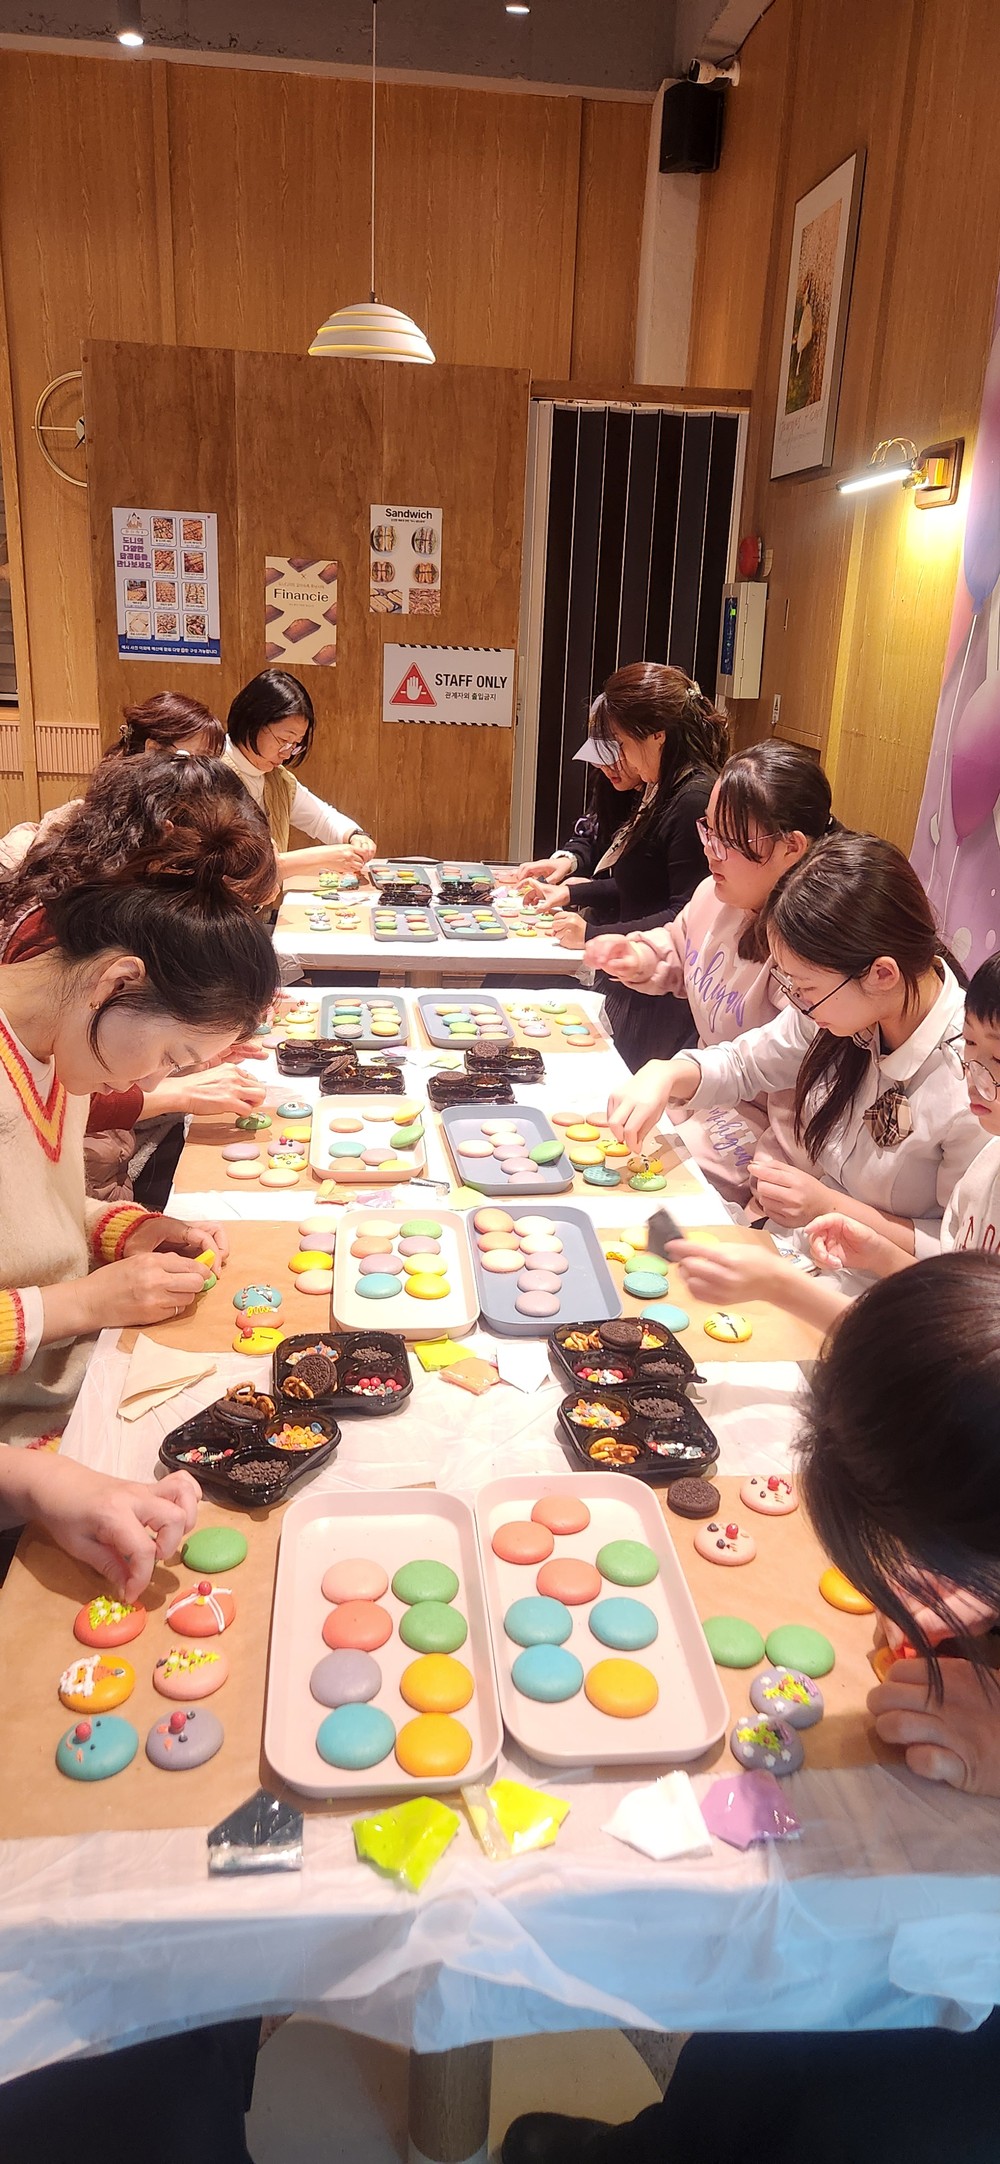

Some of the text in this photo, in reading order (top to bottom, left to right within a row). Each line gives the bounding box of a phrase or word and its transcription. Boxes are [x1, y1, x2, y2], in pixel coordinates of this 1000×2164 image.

[385, 508, 433, 519] Sandwich
[123, 544, 144, 553] 다양한
[116, 560, 152, 569] 만나보세요
[274, 588, 329, 602] Financie
[435, 673, 508, 689] STAFF ONLY
[445, 691, 497, 701] 관계자외 출입금지
